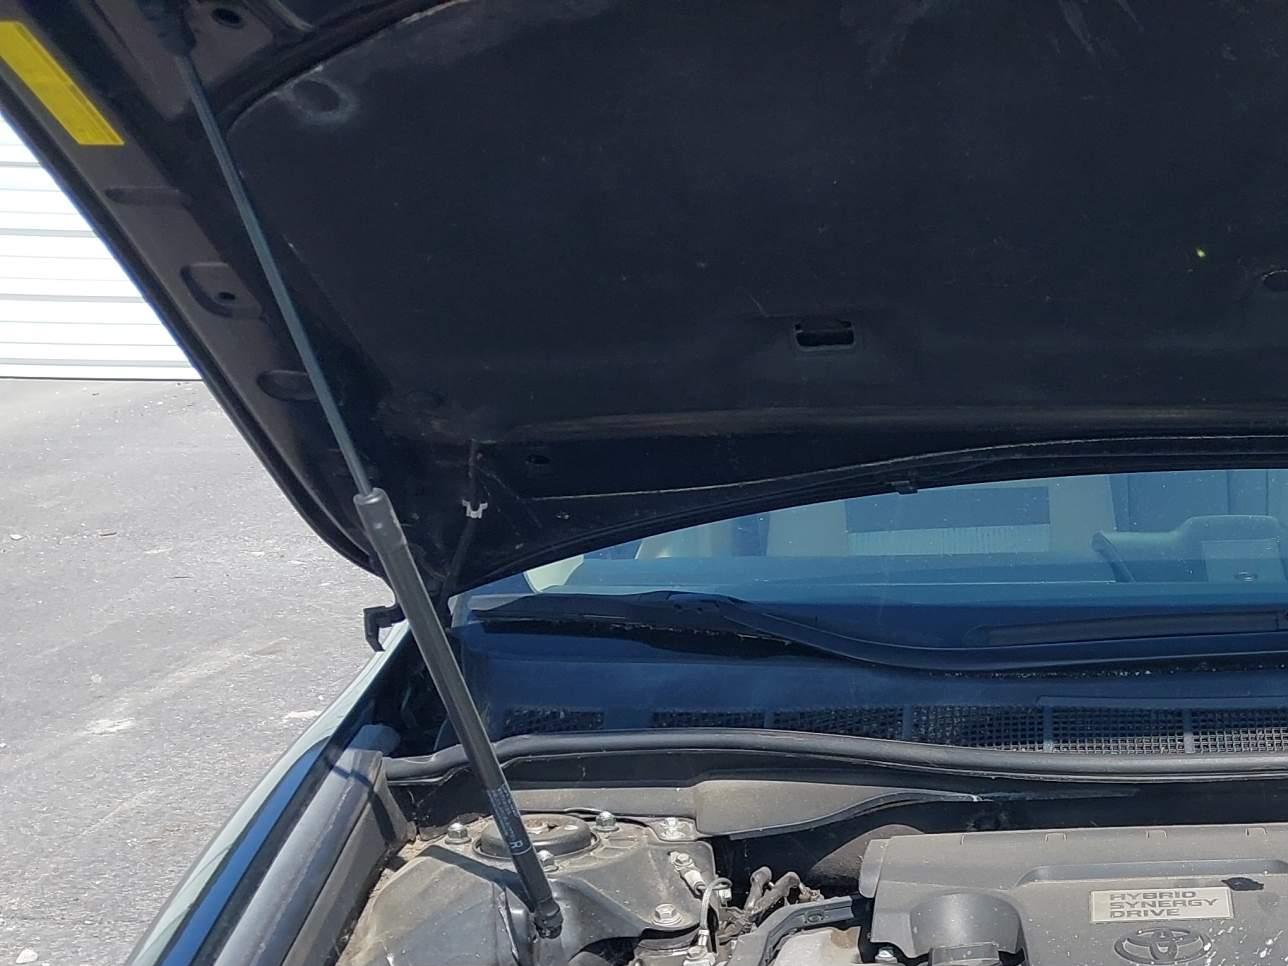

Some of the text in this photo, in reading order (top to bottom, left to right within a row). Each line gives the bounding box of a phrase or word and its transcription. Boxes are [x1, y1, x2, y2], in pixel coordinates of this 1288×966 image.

[509, 840, 523, 849] R
[1110, 890, 1197, 901] HYBRID
[1110, 898, 1218, 910] SYNERGY
[1110, 908, 1180, 918] DRIVE
